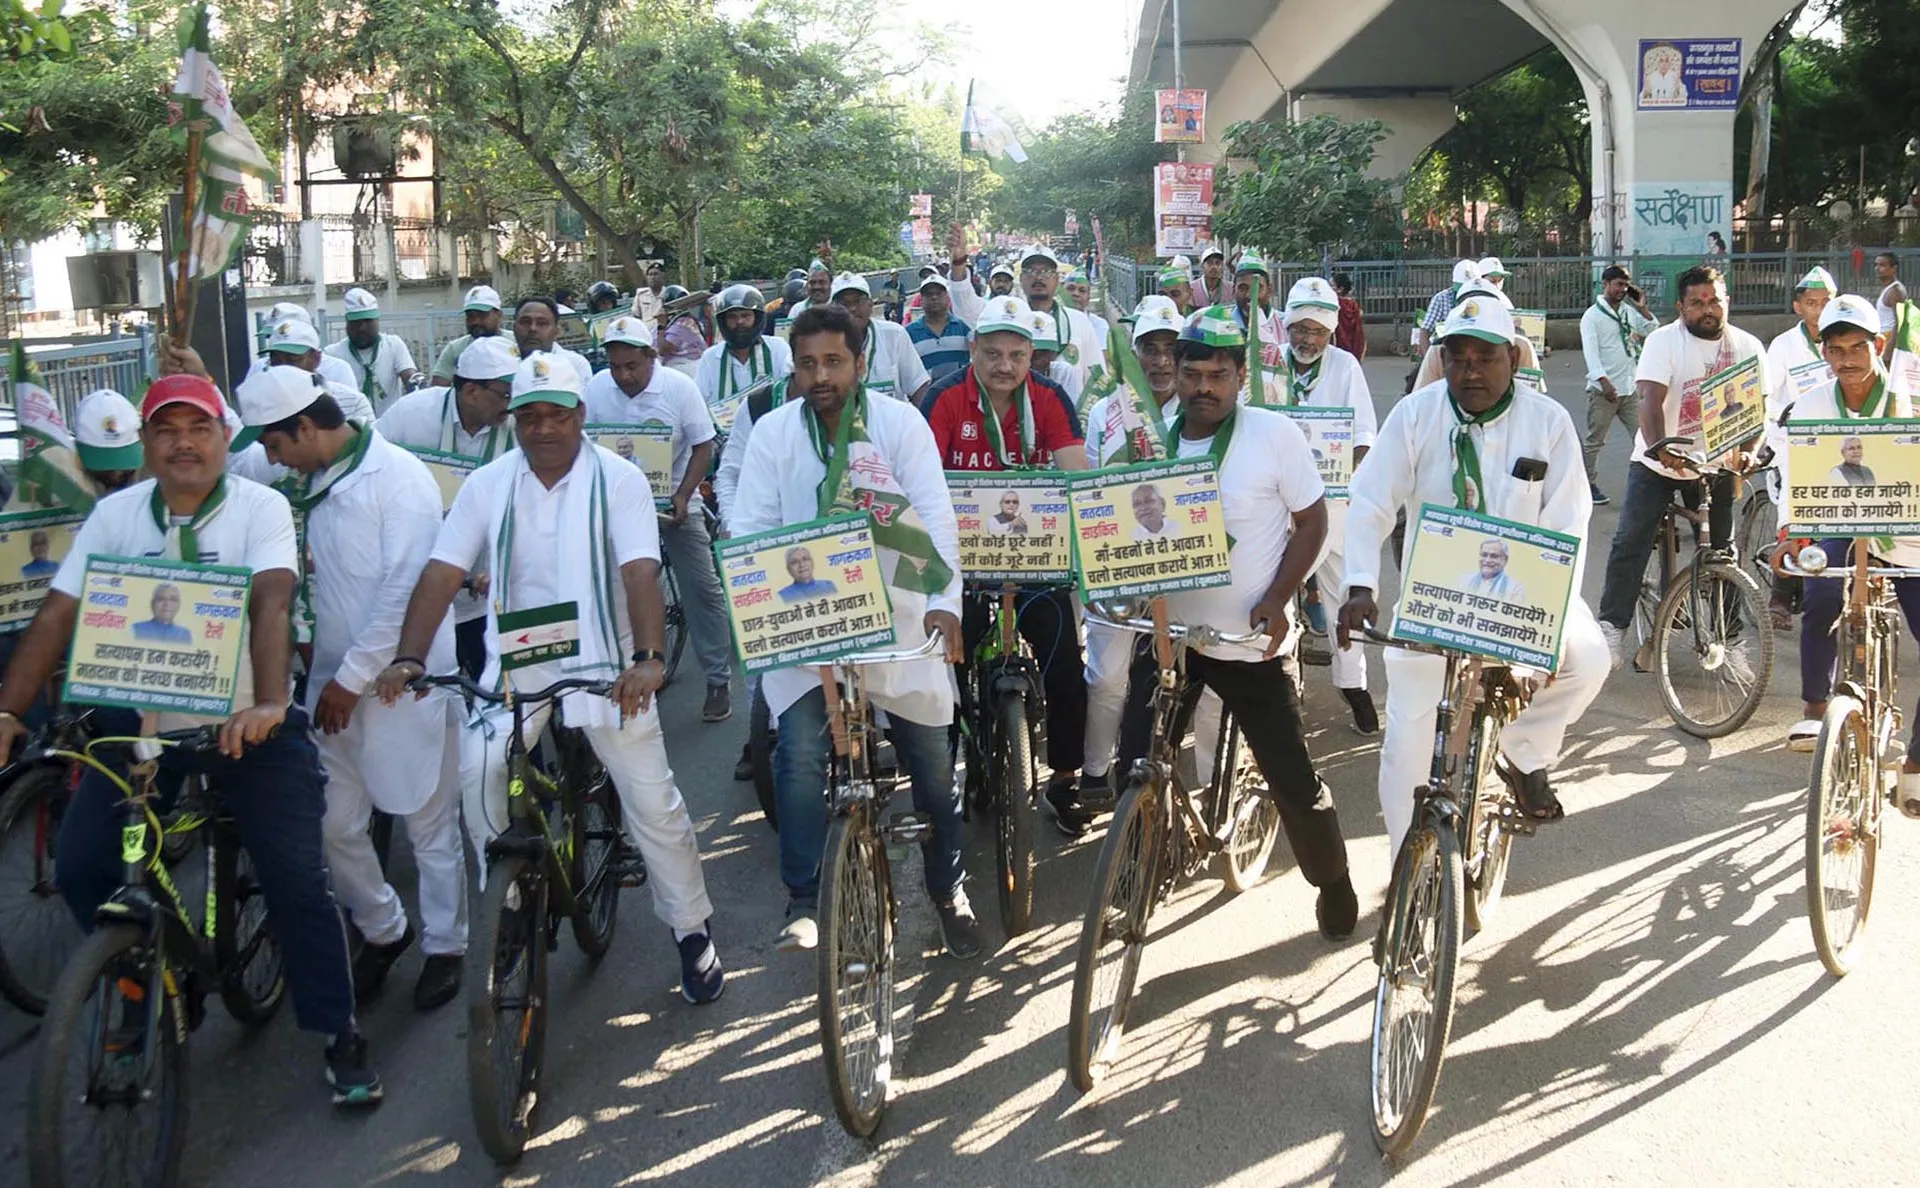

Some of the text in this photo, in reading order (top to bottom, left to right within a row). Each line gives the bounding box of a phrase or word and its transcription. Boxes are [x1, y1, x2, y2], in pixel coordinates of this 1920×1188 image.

[1635, 188, 1723, 230] सर्वेक्षण
[1791, 486, 1807, 499] हर
[1811, 486, 1828, 498] घर
[1831, 486, 1852, 498] तक
[1855, 485, 1875, 498] हम
[1878, 481, 1911, 497] जायेंगे
[1079, 504, 1114, 519] मतदाता
[1080, 506, 1208, 540] साइकिल रैली
[1793, 505, 1837, 518] मतदाता
[1841, 501, 1857, 517] को
[1860, 501, 1903, 517] जगायेंगे
[982, 534, 1005, 547] कोई
[1007, 534, 1026, 551] छूटे
[1029, 533, 1055, 547] नहीं
[1094, 540, 1143, 562] माँ-बहनों
[1143, 539, 1155, 555] ने
[1156, 536, 1169, 553] दी
[1171, 535, 1205, 552] आवाज
[978, 552, 1002, 566] कोई
[1026, 552, 1052, 565] नहीं
[1086, 565, 1110, 583] चलो
[1111, 563, 1156, 581] सत्यापन
[1157, 554, 1188, 574] करायें
[1190, 554, 1214, 569] आज
[730, 570, 766, 587] मतदाता
[732, 565, 863, 608] साइकिल रैली
[741, 604, 803, 633] छात्र-युवाओं
[803, 602, 816, 618] ने
[816, 598, 830, 615] दी
[832, 594, 867, 613] आवाज
[1412, 581, 1464, 604] सत्यापन
[1466, 593, 1500, 613] जरूर
[1501, 602, 1547, 625] करायेंगे
[742, 634, 768, 654] चलो
[768, 628, 814, 649] सत्यापन
[815, 617, 848, 638] करायें
[849, 615, 874, 631] आज
[1405, 599, 1438, 619] औरों
[1437, 608, 1456, 624] को
[1456, 612, 1475, 628] भी
[1477, 617, 1538, 644] समझायेंगे
[95, 643, 145, 662] सत्यापन
[147, 649, 167, 664] हम
[169, 649, 211, 669] करायेंगे
[76, 663, 120, 681] मतदान
[121, 663, 139, 683] को
